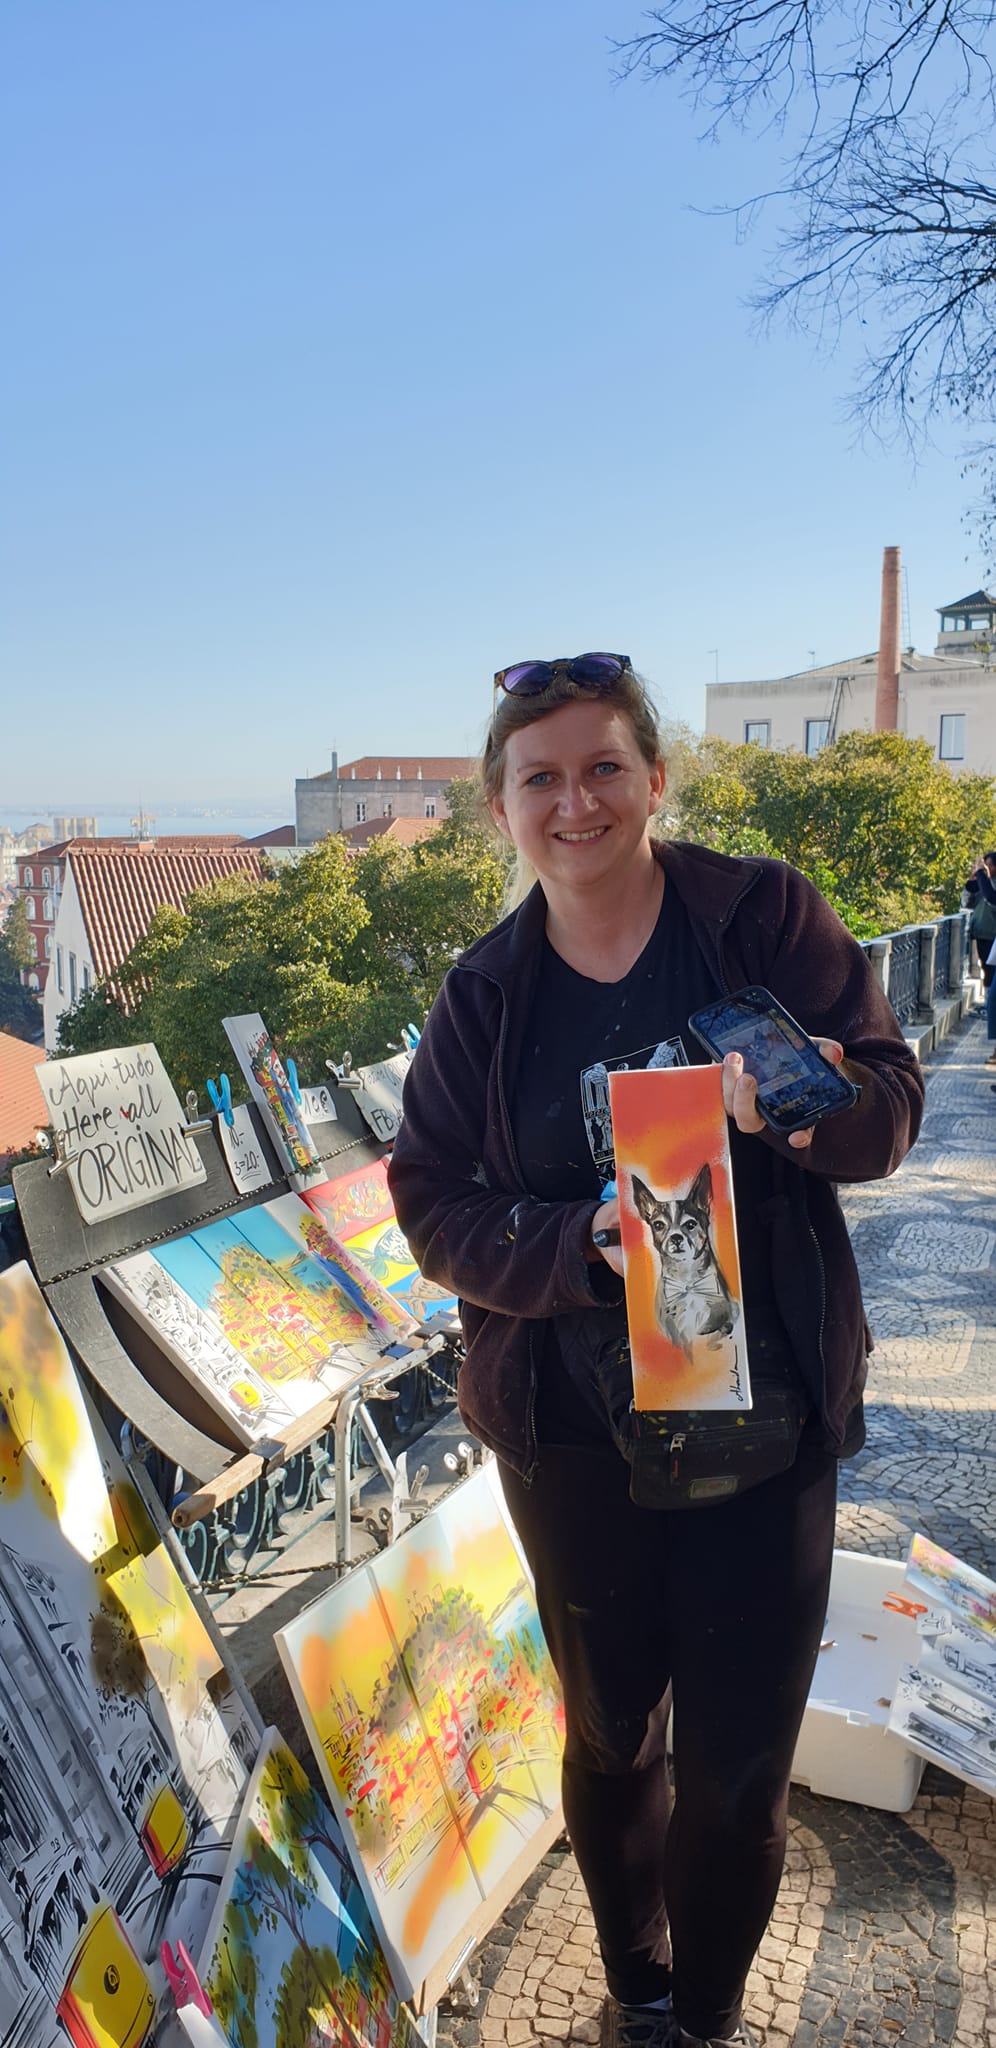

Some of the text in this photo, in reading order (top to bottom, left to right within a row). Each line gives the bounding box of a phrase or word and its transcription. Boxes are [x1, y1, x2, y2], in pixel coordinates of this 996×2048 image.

[50, 1052, 154, 1107] Aqui tudo
[62, 1084, 163, 1148] Here all
